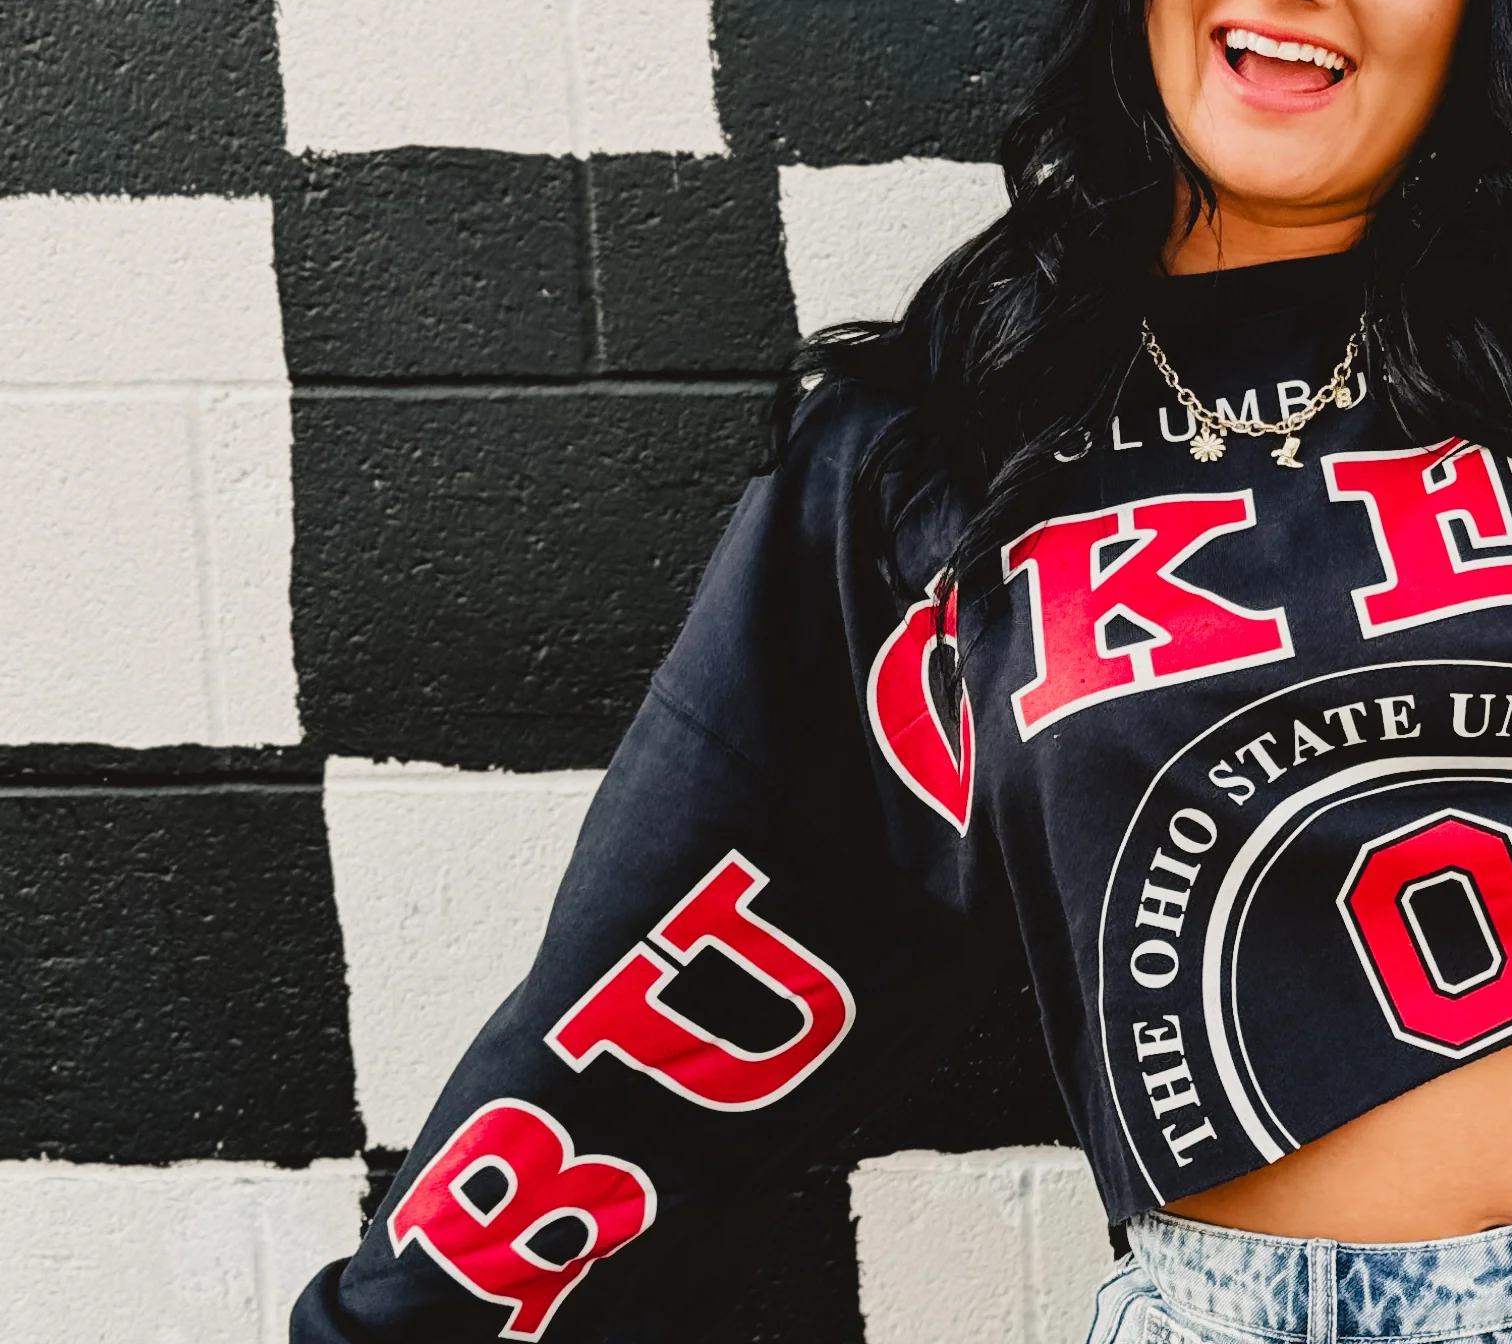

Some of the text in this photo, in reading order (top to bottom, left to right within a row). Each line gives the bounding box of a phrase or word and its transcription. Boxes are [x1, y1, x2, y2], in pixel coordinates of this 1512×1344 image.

[1207, 693, 1422, 807] STATE
[1129, 807, 1218, 990] OHIO
[1132, 1014, 1218, 1168] THE
